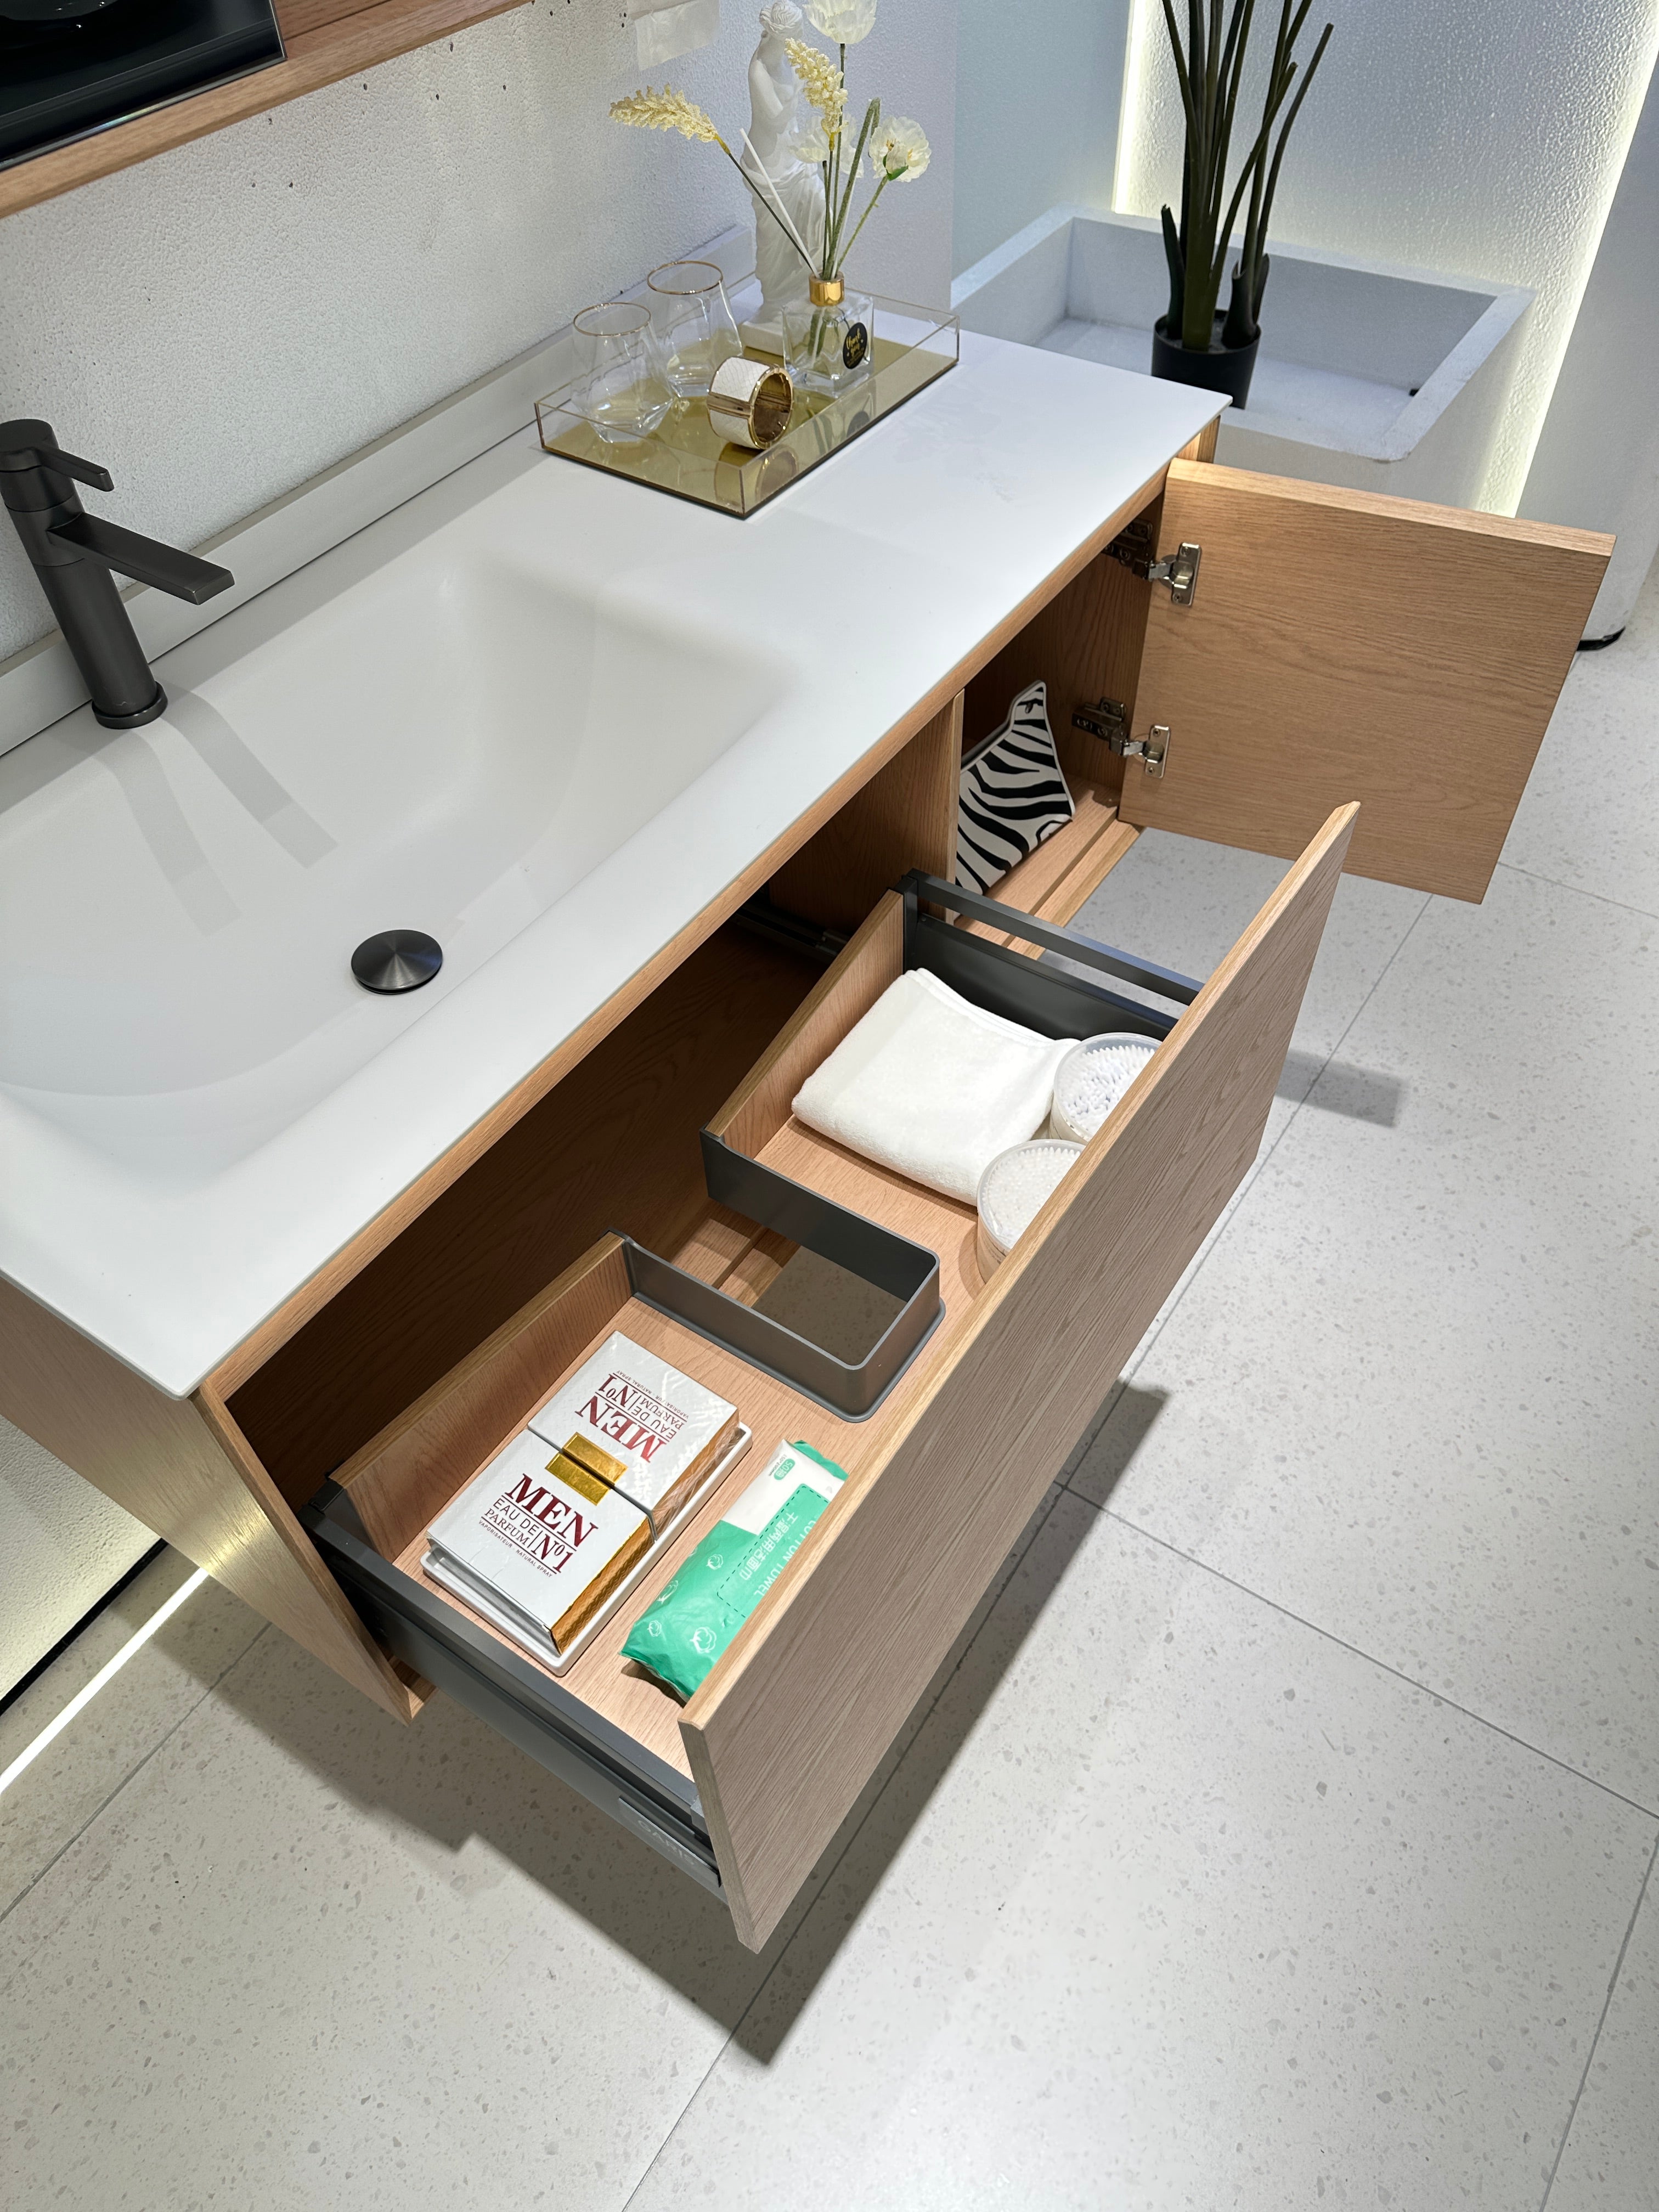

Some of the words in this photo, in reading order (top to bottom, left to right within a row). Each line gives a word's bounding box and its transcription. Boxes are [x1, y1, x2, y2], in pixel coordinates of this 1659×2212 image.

[616, 1370, 631, 1380] SPRAY
[632, 1379, 652, 1394] NATURAL
[574, 1395, 667, 1463] MEN
[631, 1406, 650, 1421] DE
[640, 1397, 684, 1430] PARFUM
[650, 1420, 676, 1439] EAU
[484, 1508, 530, 1545] PARFUM
[493, 1498, 520, 1520] EAU
[520, 1518, 539, 1535] DE
[504, 1473, 599, 1547] MEN
[479, 1520, 512, 1548] VAPORISATEUR
[516, 1549, 536, 1566] NATURAL
[537, 1565, 552, 1577] SPRAY
[739, 1511, 798, 1581] 干湿两用洁面巾
